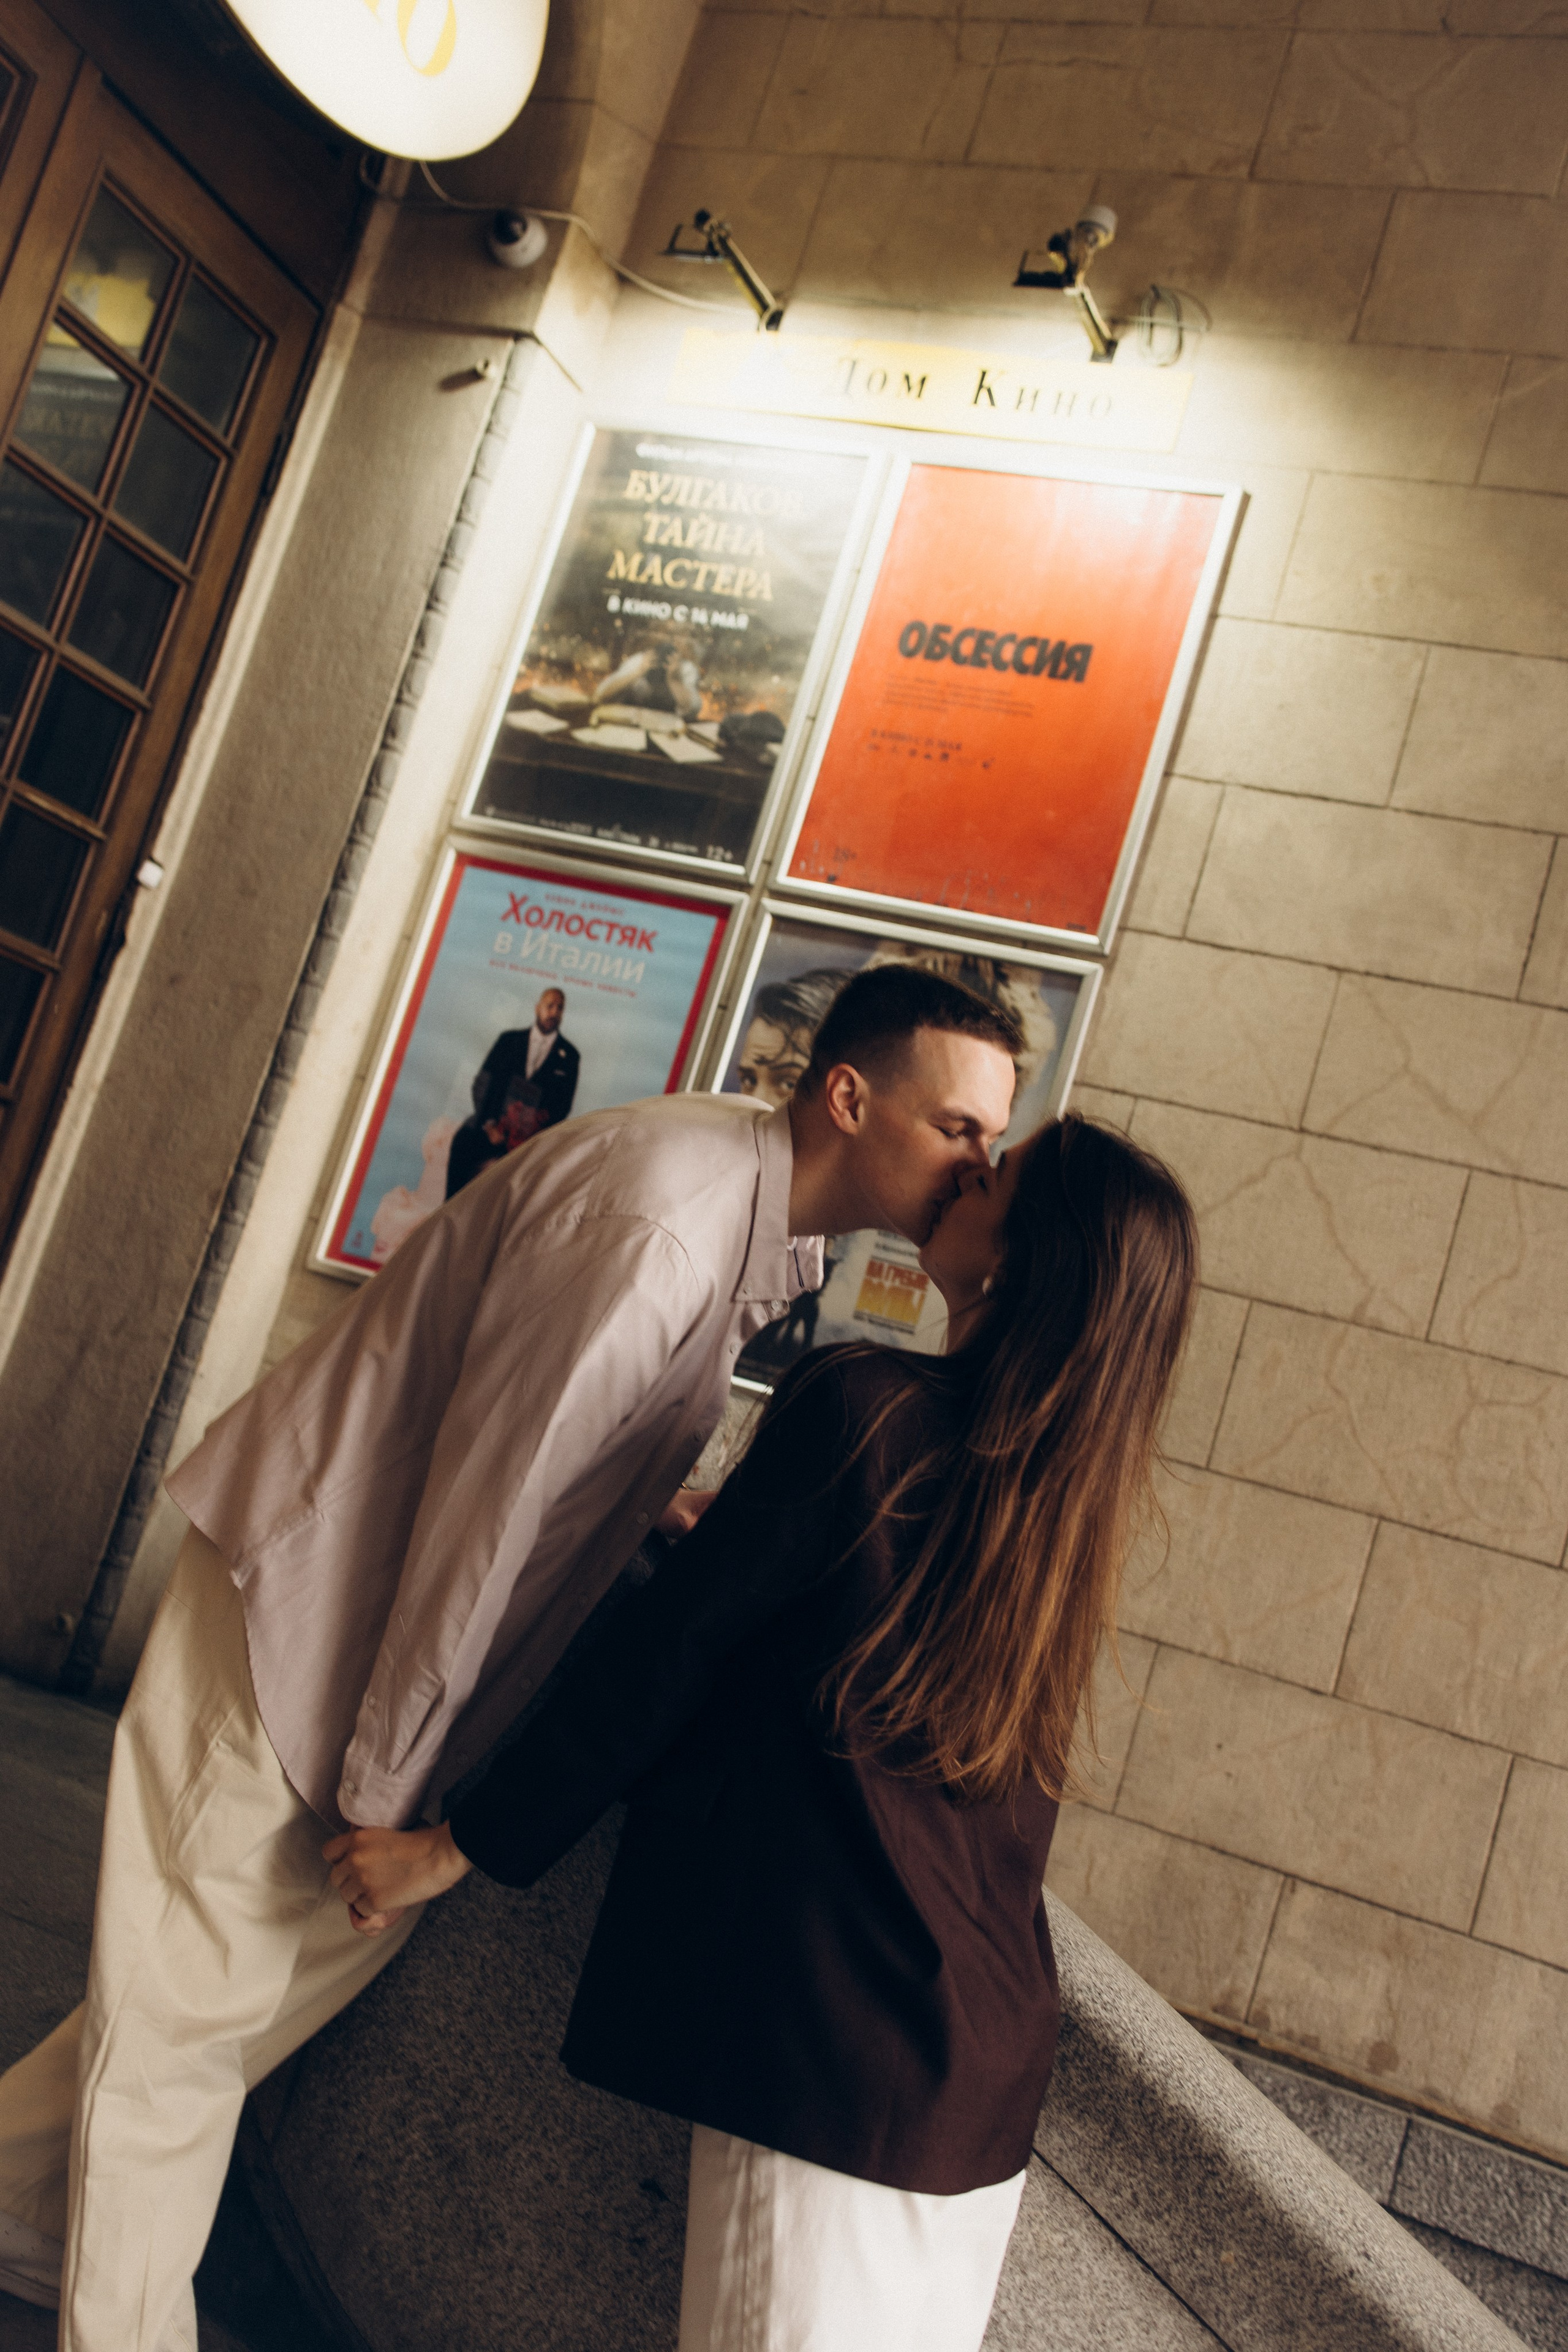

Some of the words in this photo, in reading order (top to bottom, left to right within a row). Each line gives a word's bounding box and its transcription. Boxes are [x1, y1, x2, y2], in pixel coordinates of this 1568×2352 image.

[971, 369, 1114, 420] Кино
[644, 512, 766, 556] ТАЙНА
[606, 550, 773, 601] МАСТЕРА
[897, 619, 1094, 684] ОБСЕССИЯ
[520, 929, 646, 984] Италии
